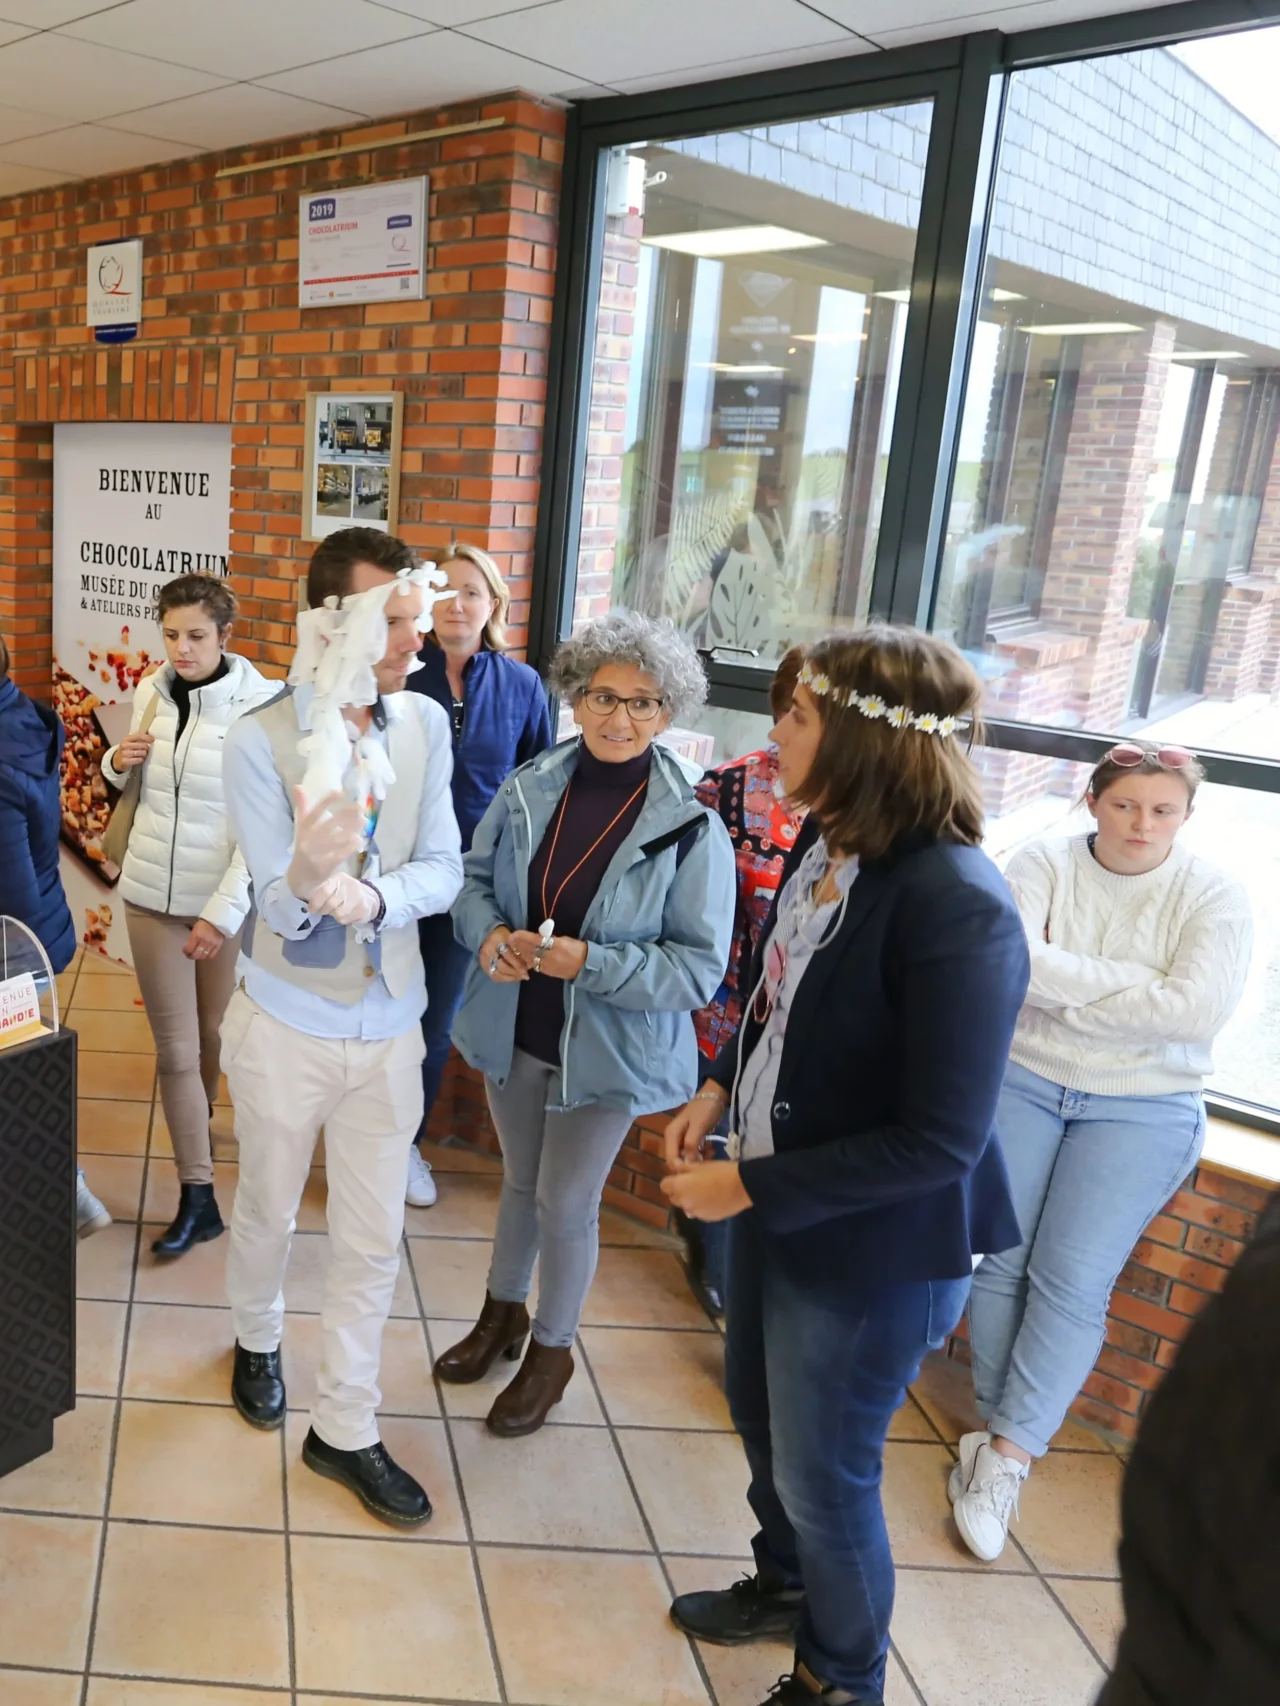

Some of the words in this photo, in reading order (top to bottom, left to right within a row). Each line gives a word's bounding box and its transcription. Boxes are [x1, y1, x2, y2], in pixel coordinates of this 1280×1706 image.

[311, 203, 334, 218] 2019
[309, 221, 358, 236] CHOCOLATRIUM
[99, 468, 210, 497] BIENVENUE
[145, 503, 162, 520] AU
[80, 573, 125, 597] MUSÉE
[129, 581, 148, 600] DU
[80, 597, 88, 609] &
[90, 598, 141, 618] ATELIERS
